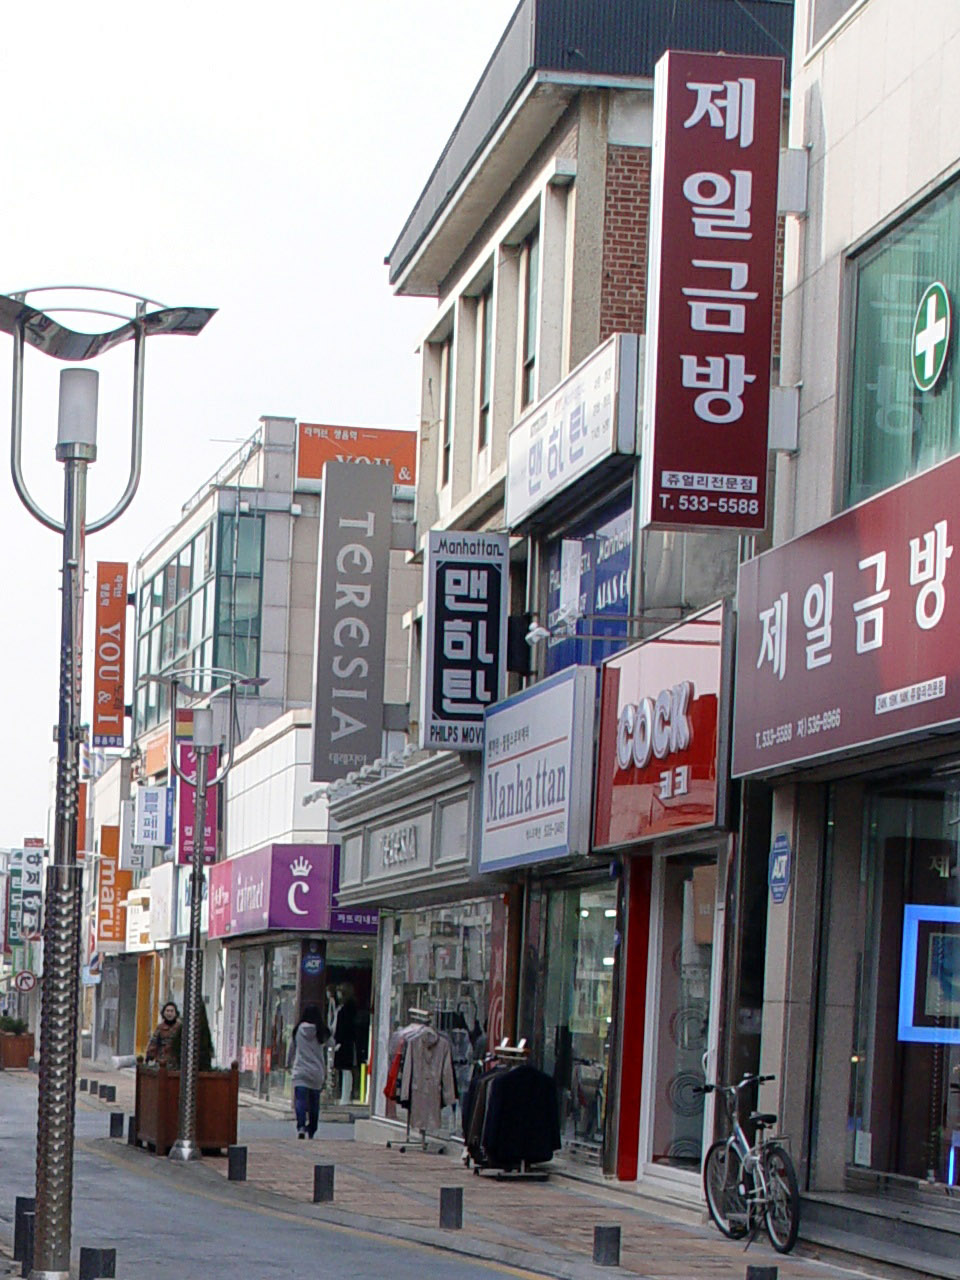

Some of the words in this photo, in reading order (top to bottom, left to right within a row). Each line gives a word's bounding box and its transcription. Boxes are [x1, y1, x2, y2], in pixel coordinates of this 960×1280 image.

[680, 78, 759, 424] 제일금방
[398, 467, 411, 480] &
[666, 472, 754, 492] 쥬얼리전문점
[678, 496, 759, 516] 533-5588
[433, 538, 504, 557] Manhattan
[757, 520, 954, 681] 제일금방
[98, 622, 121, 681] YOU
[617, 681, 695, 771] COCK
[486, 757, 567, 823] Manhattan
[772, 854, 788, 880] ADT
[99, 859, 117, 938] maru
